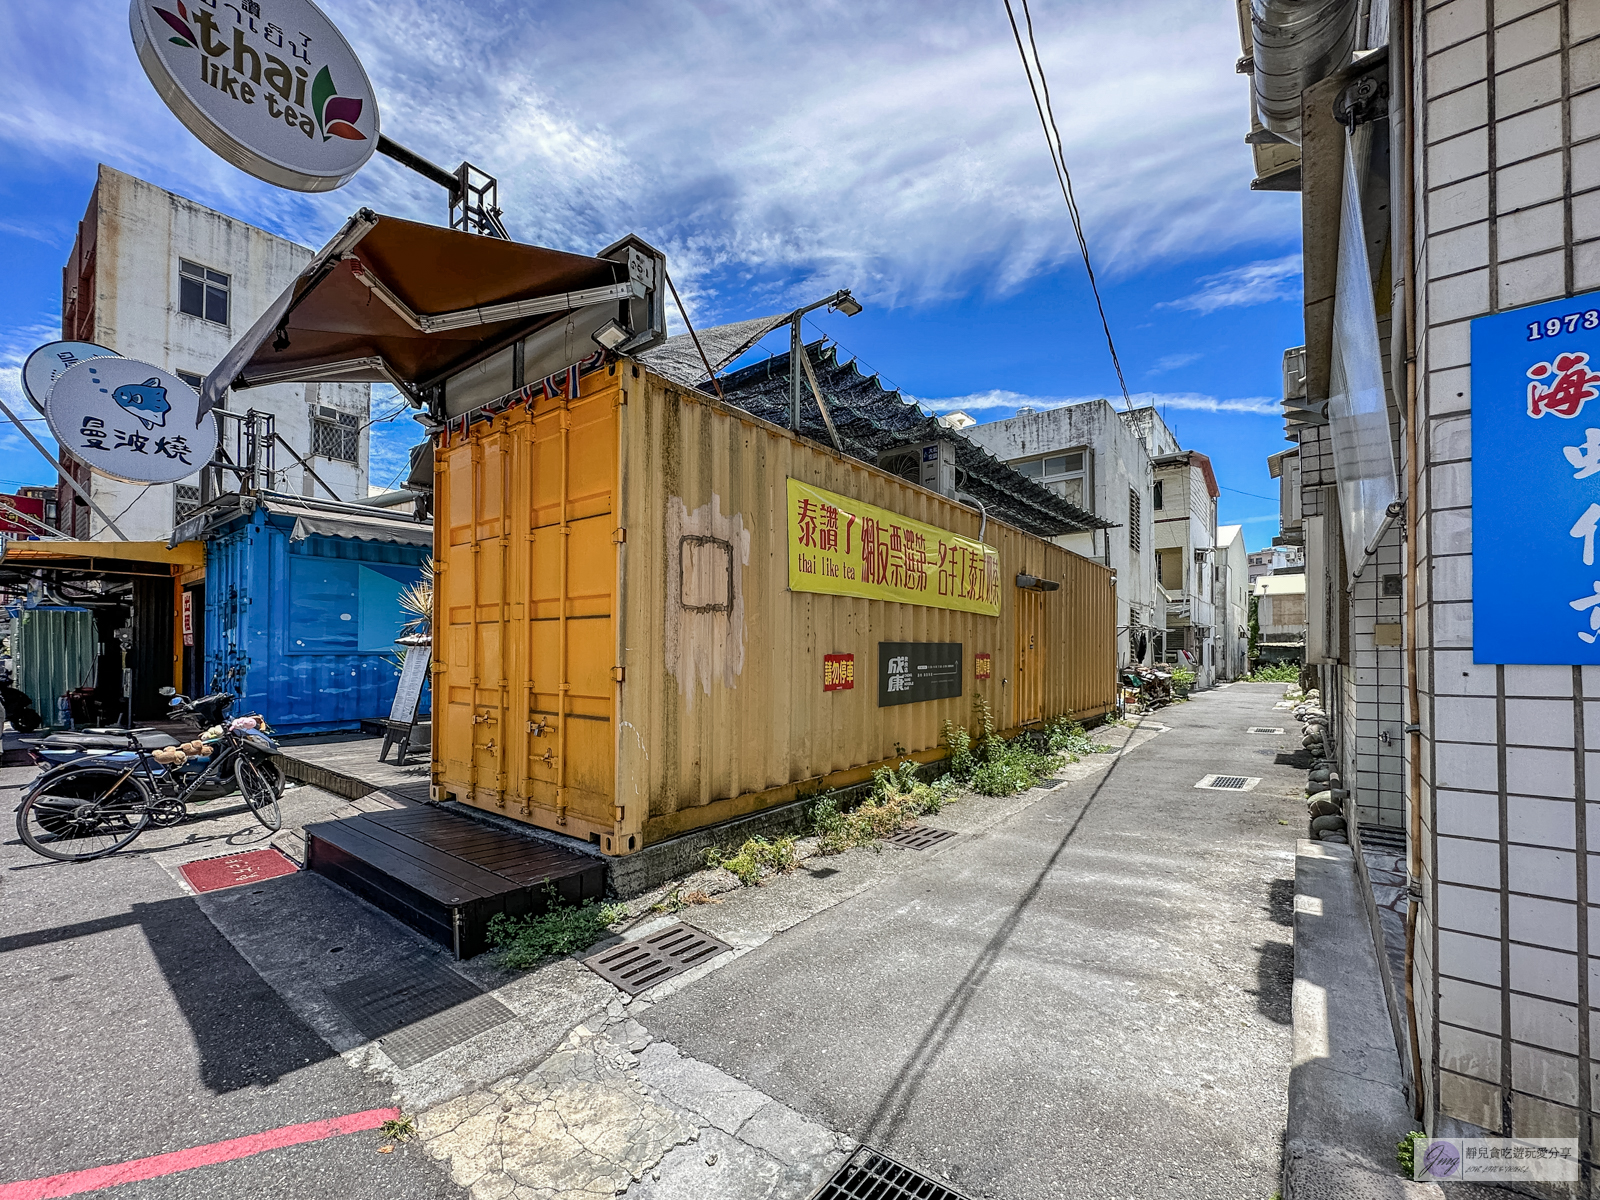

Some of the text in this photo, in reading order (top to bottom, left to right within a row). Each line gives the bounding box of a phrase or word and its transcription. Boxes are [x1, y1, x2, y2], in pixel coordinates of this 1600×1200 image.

[192, 7, 309, 108] thai
[200, 54, 315, 139] like tea
[1527, 309, 1600, 341] 1973
[1526, 352, 1600, 418] 海
[80, 416, 192, 465] 曼波燒
[798, 553, 855, 580] thai like tea
[825, 660, 853, 685] 請勿停車
